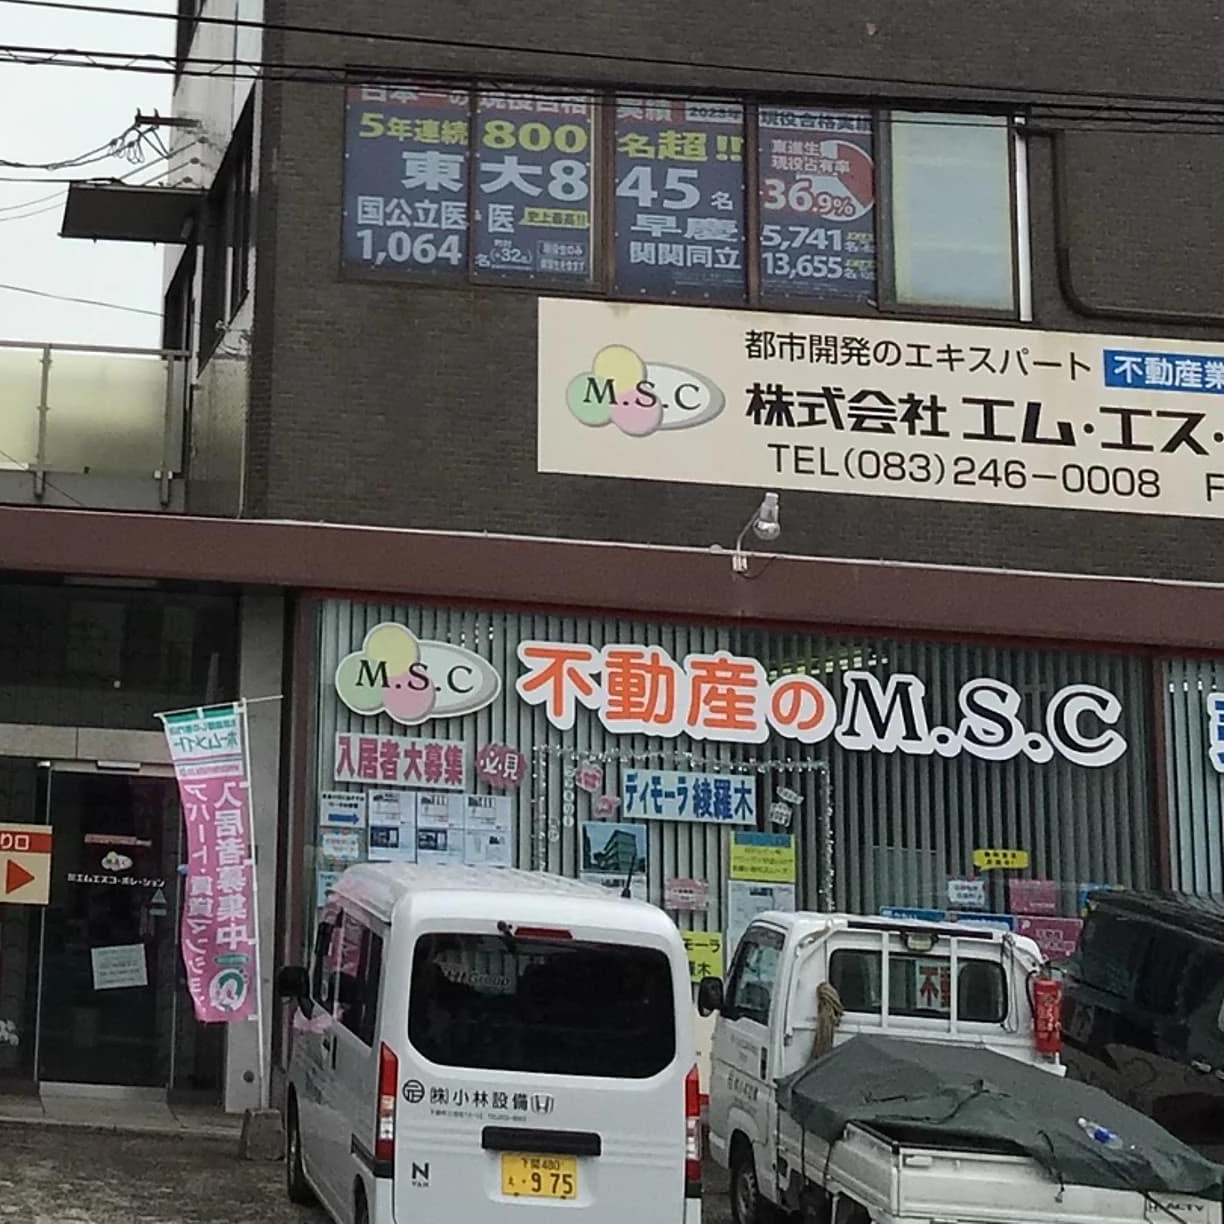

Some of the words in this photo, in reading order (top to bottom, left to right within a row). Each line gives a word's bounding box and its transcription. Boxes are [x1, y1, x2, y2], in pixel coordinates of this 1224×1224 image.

[764, 178, 854, 217] 36.9%
[630, 214, 738, 242] 早慶
[630, 241, 741, 269] 関関同立
[745, 330, 1091, 381] 都市開発のエキスパート
[583, 376, 702, 411] M.S.C
[355, 658, 474, 695] M.S.C
[480, 751, 518, 780] 必見
